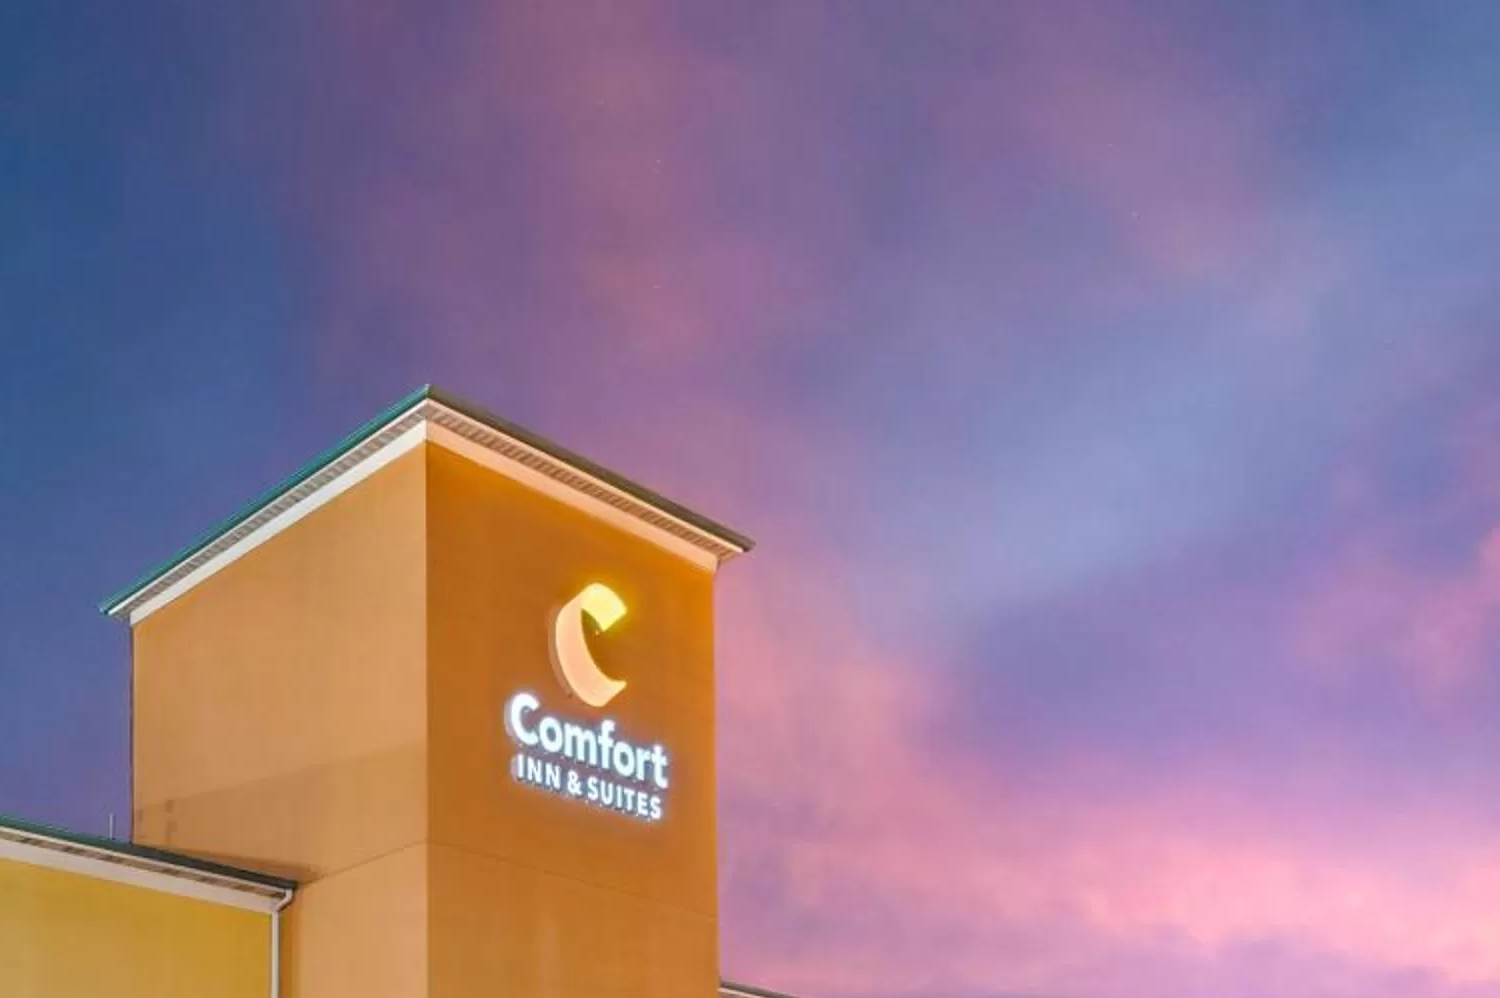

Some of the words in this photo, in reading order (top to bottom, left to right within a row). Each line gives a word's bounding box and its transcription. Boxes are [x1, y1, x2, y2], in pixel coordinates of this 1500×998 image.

[509, 692, 668, 789] Comfort
[516, 753, 561, 789] INN
[567, 769, 582, 796] &
[587, 776, 662, 819] SUITES
